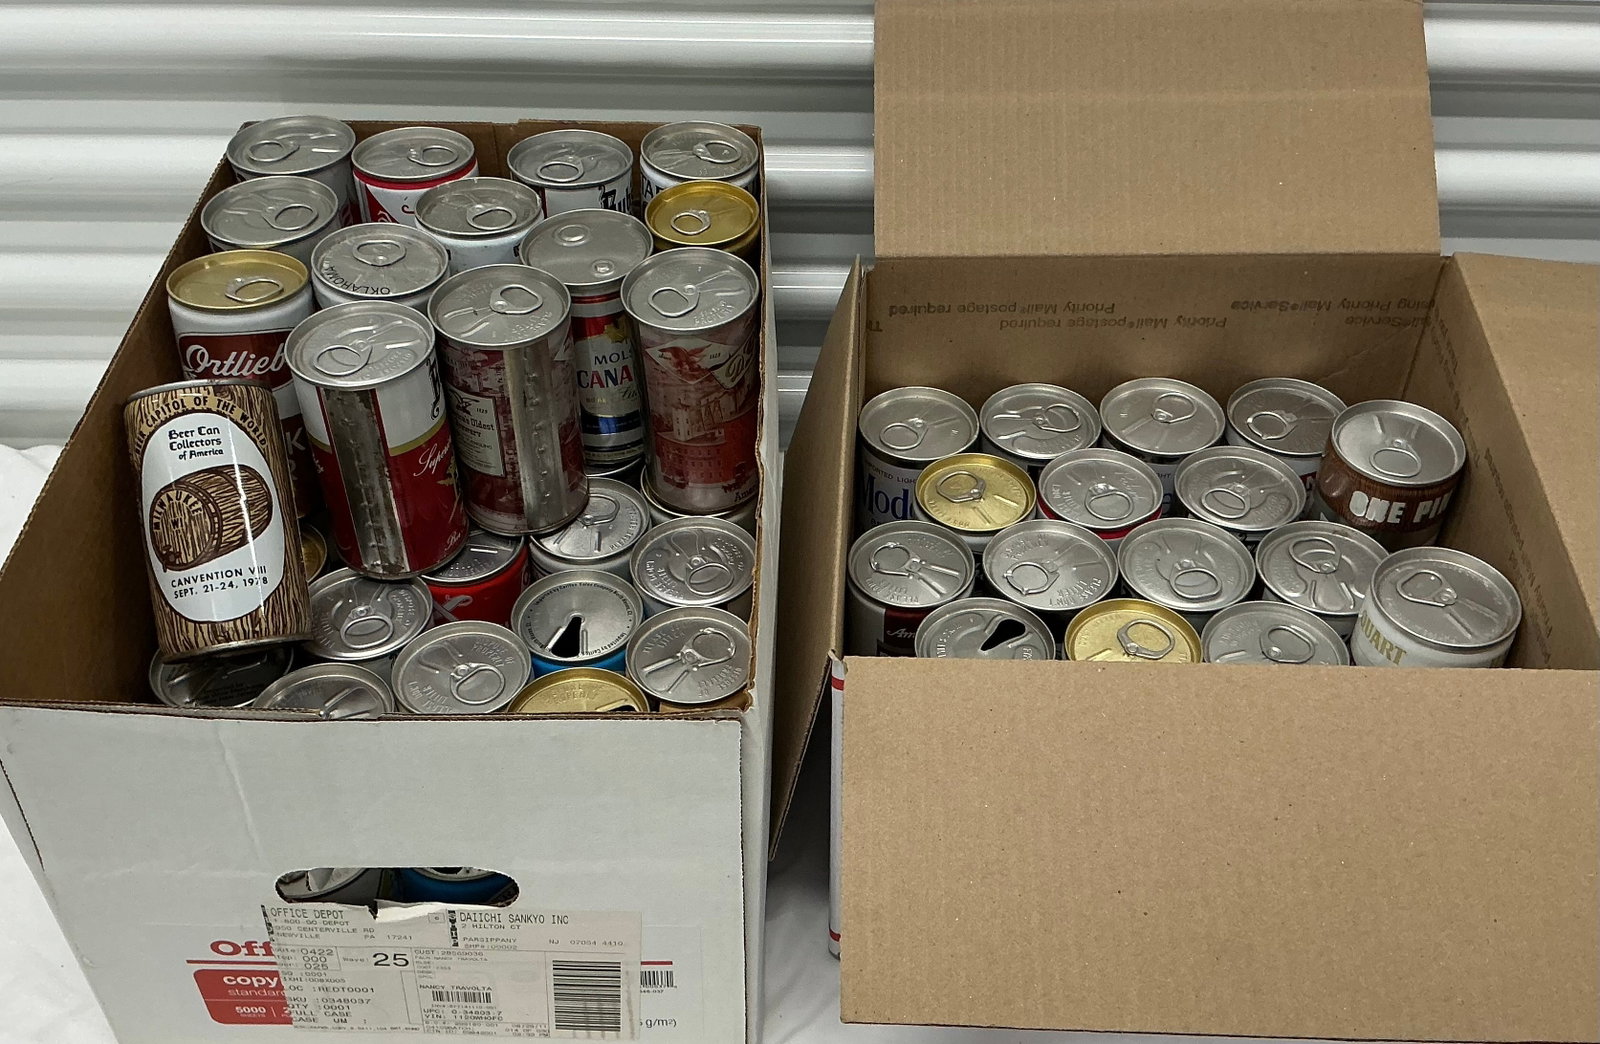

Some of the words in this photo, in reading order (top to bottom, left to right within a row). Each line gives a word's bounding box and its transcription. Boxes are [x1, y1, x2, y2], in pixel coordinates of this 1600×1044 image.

[322, 263, 390, 295] OKLAHOMA
[888, 302, 951, 317] required
[957, 302, 1018, 315] postage
[1063, 301, 1115, 315] Priority
[145, 399, 187, 428] CAPITOL
[194, 396, 208, 406] OF
[216, 400, 236, 414] THE
[240, 413, 267, 446] WORLD
[168, 429, 195, 441] Beer
[198, 426, 220, 436] Can
[169, 437, 222, 451] Collectors
[179, 450, 187, 461] of
[189, 448, 224, 459] America
[153, 489, 203, 531] MILWAUKEE
[1350, 490, 1406, 524] ONE
[171, 568, 243, 588] CANVENTION
[173, 587, 198, 599] SEPT.
[203, 581, 238, 593] 21-24,
[1361, 610, 1407, 665] QUART
[271, 908, 308, 919] OFFICE
[314, 909, 344, 920] DEPOT
[460, 912, 502, 924] DAIICHI
[508, 914, 545, 925] SANKYO
[552, 915, 569, 925] INC
[297, 926, 358, 934] CENTERVILLE
[301, 948, 334, 957] 0422
[372, 952, 409, 967] 25
[223, 976, 278, 987] copy
[235, 1006, 266, 1014] 5000
